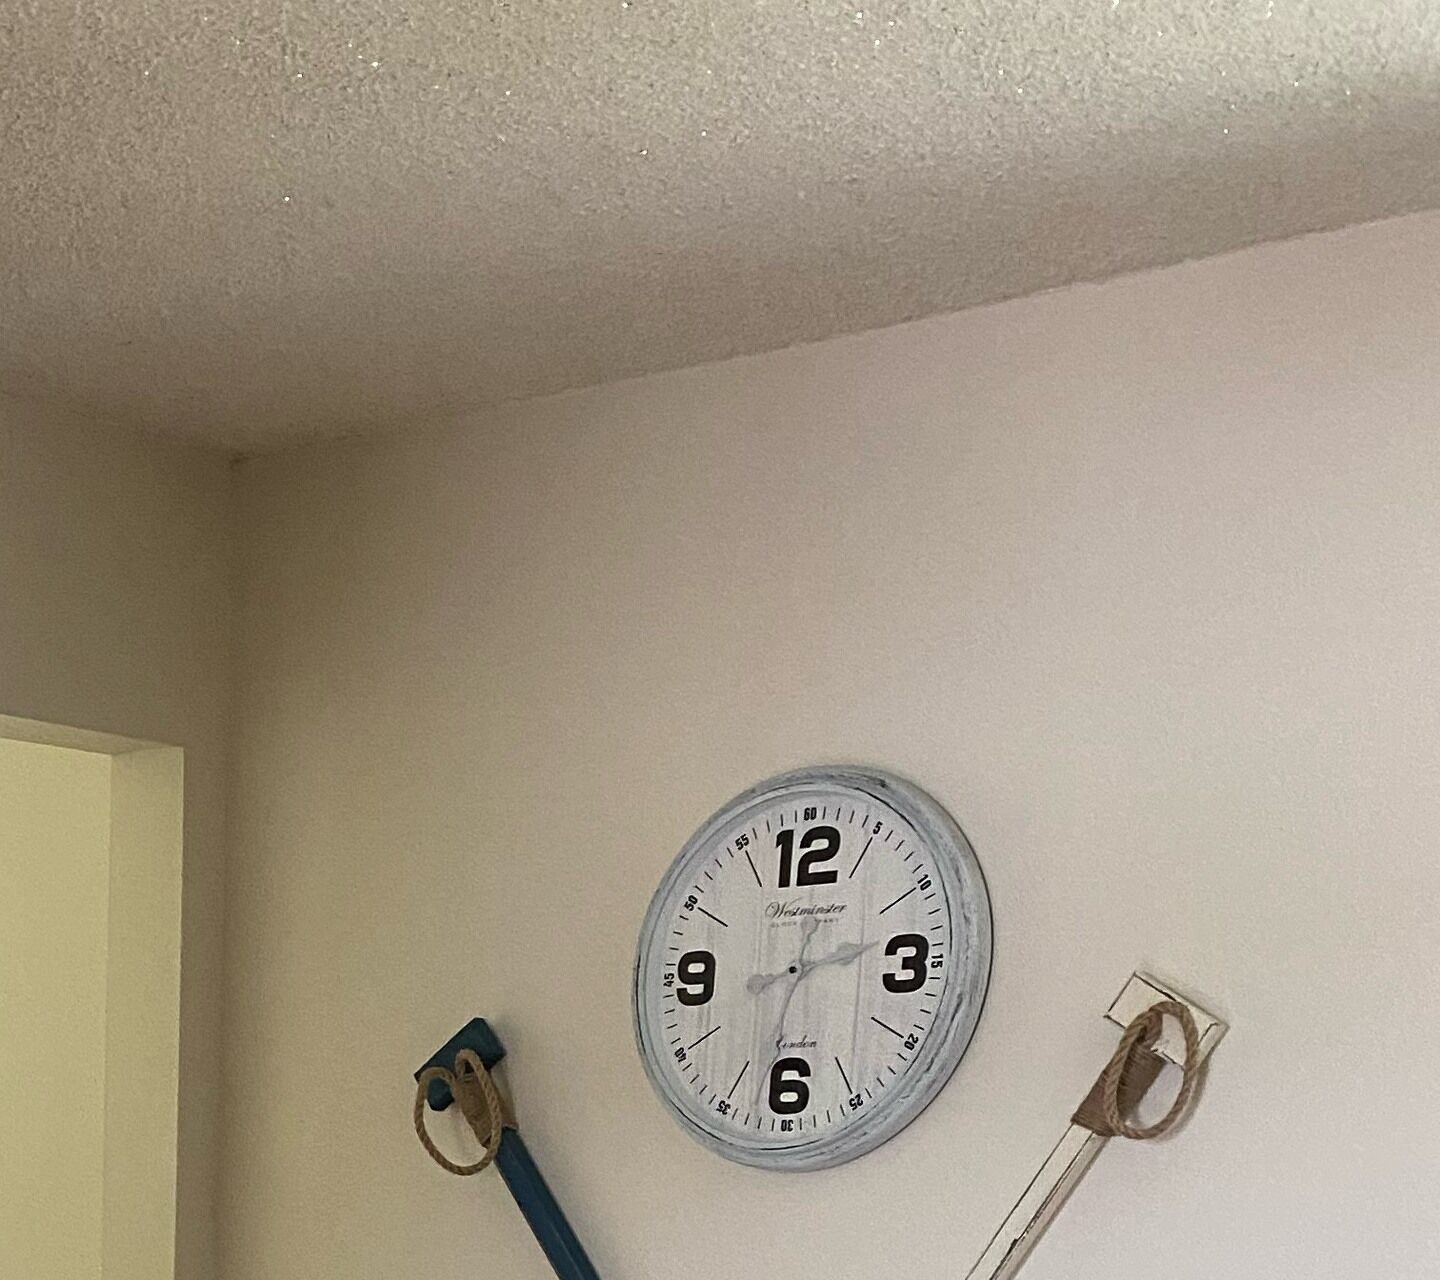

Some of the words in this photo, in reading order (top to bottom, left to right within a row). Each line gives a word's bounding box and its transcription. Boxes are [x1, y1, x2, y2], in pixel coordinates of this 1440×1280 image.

[804, 808, 817, 820] 60
[874, 821, 883, 835] 5
[735, 834, 750, 851] 55
[775, 826, 841, 888] 12
[917, 874, 932, 891] 10
[683, 896, 698, 912] 50
[765, 898, 847, 919] Westminster
[882, 933, 929, 993] 3
[931, 953, 943, 970] 15
[664, 973, 675, 988] 45
[676, 950, 716, 1006] 9
[904, 1035, 919, 1052] 20
[674, 1046, 687, 1063] 40
[769, 1057, 811, 1115] 6
[716, 1099, 731, 1116] 35
[849, 1094, 864, 1112] 25
[781, 1119, 794, 1132] 30
